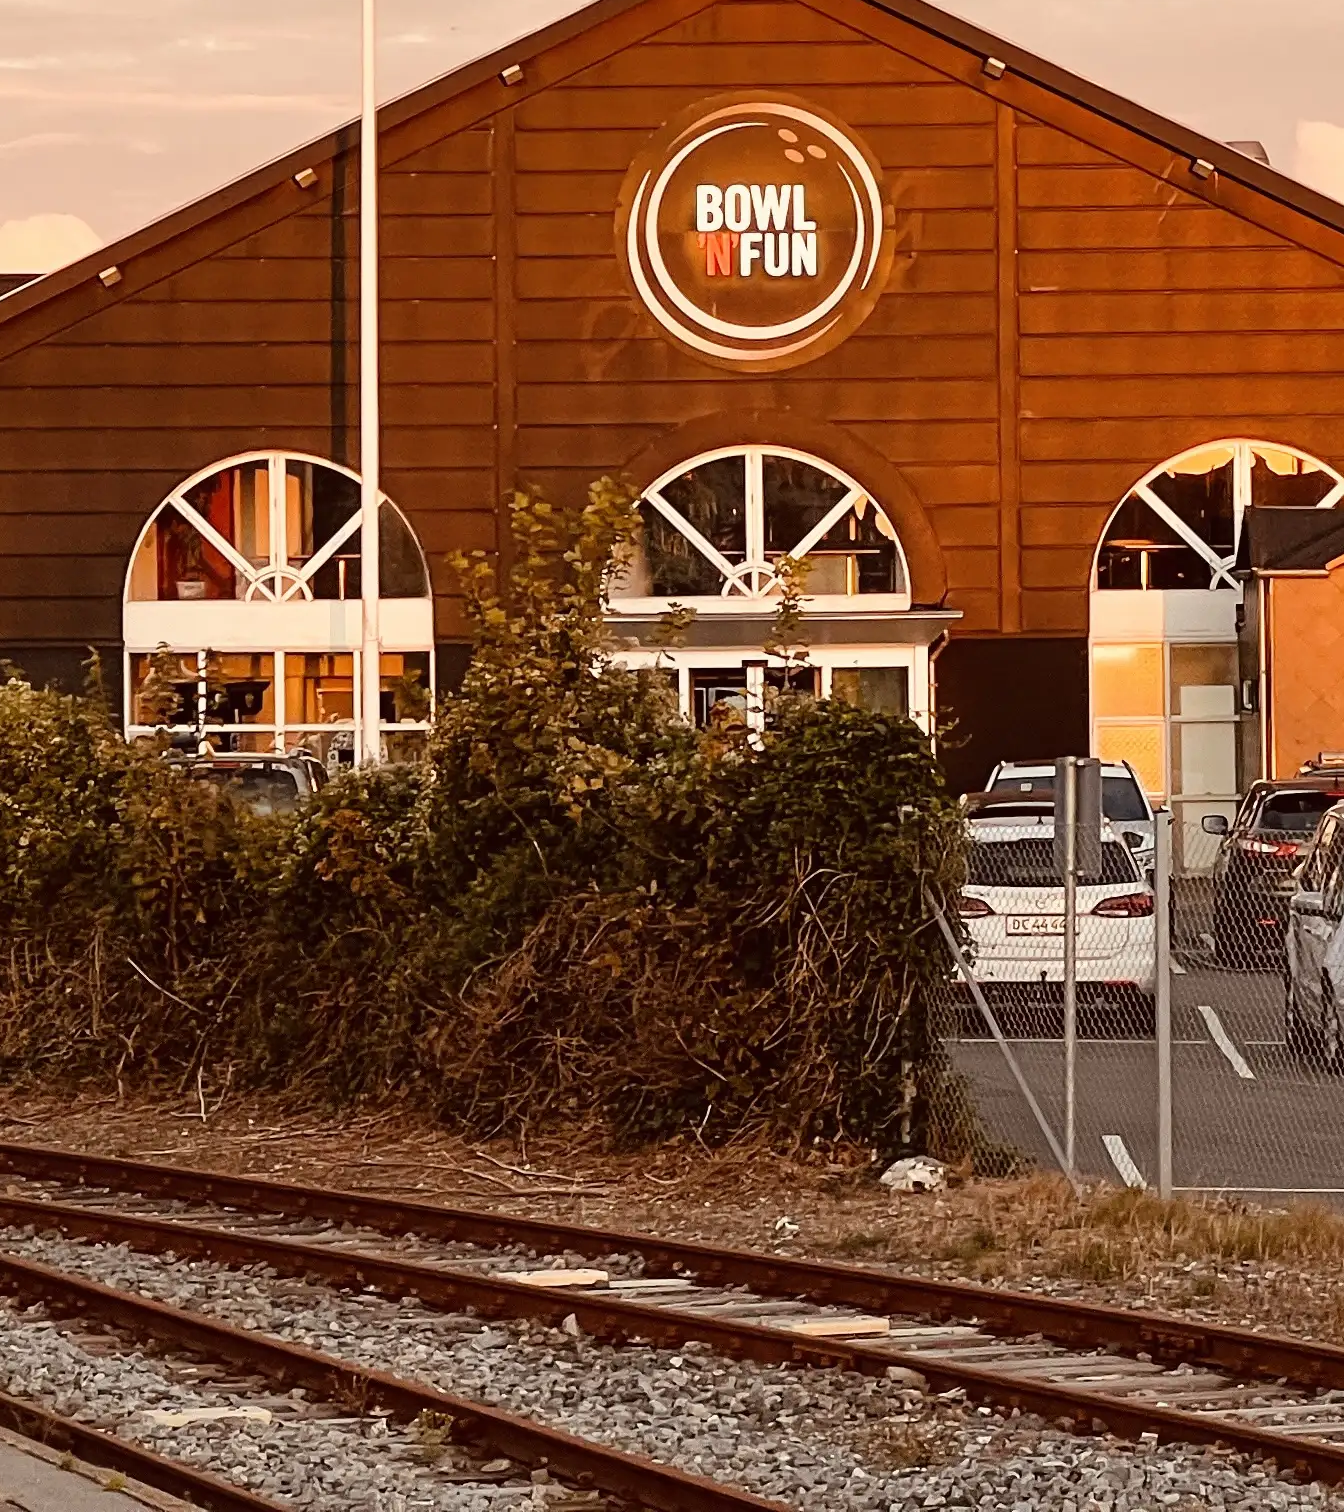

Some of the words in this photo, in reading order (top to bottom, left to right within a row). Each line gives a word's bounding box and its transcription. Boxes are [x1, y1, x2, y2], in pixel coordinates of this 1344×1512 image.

[696, 184, 816, 232] BOWL
[1012, 918, 1030, 930] DC
[1032, 918, 1048, 930] 44
